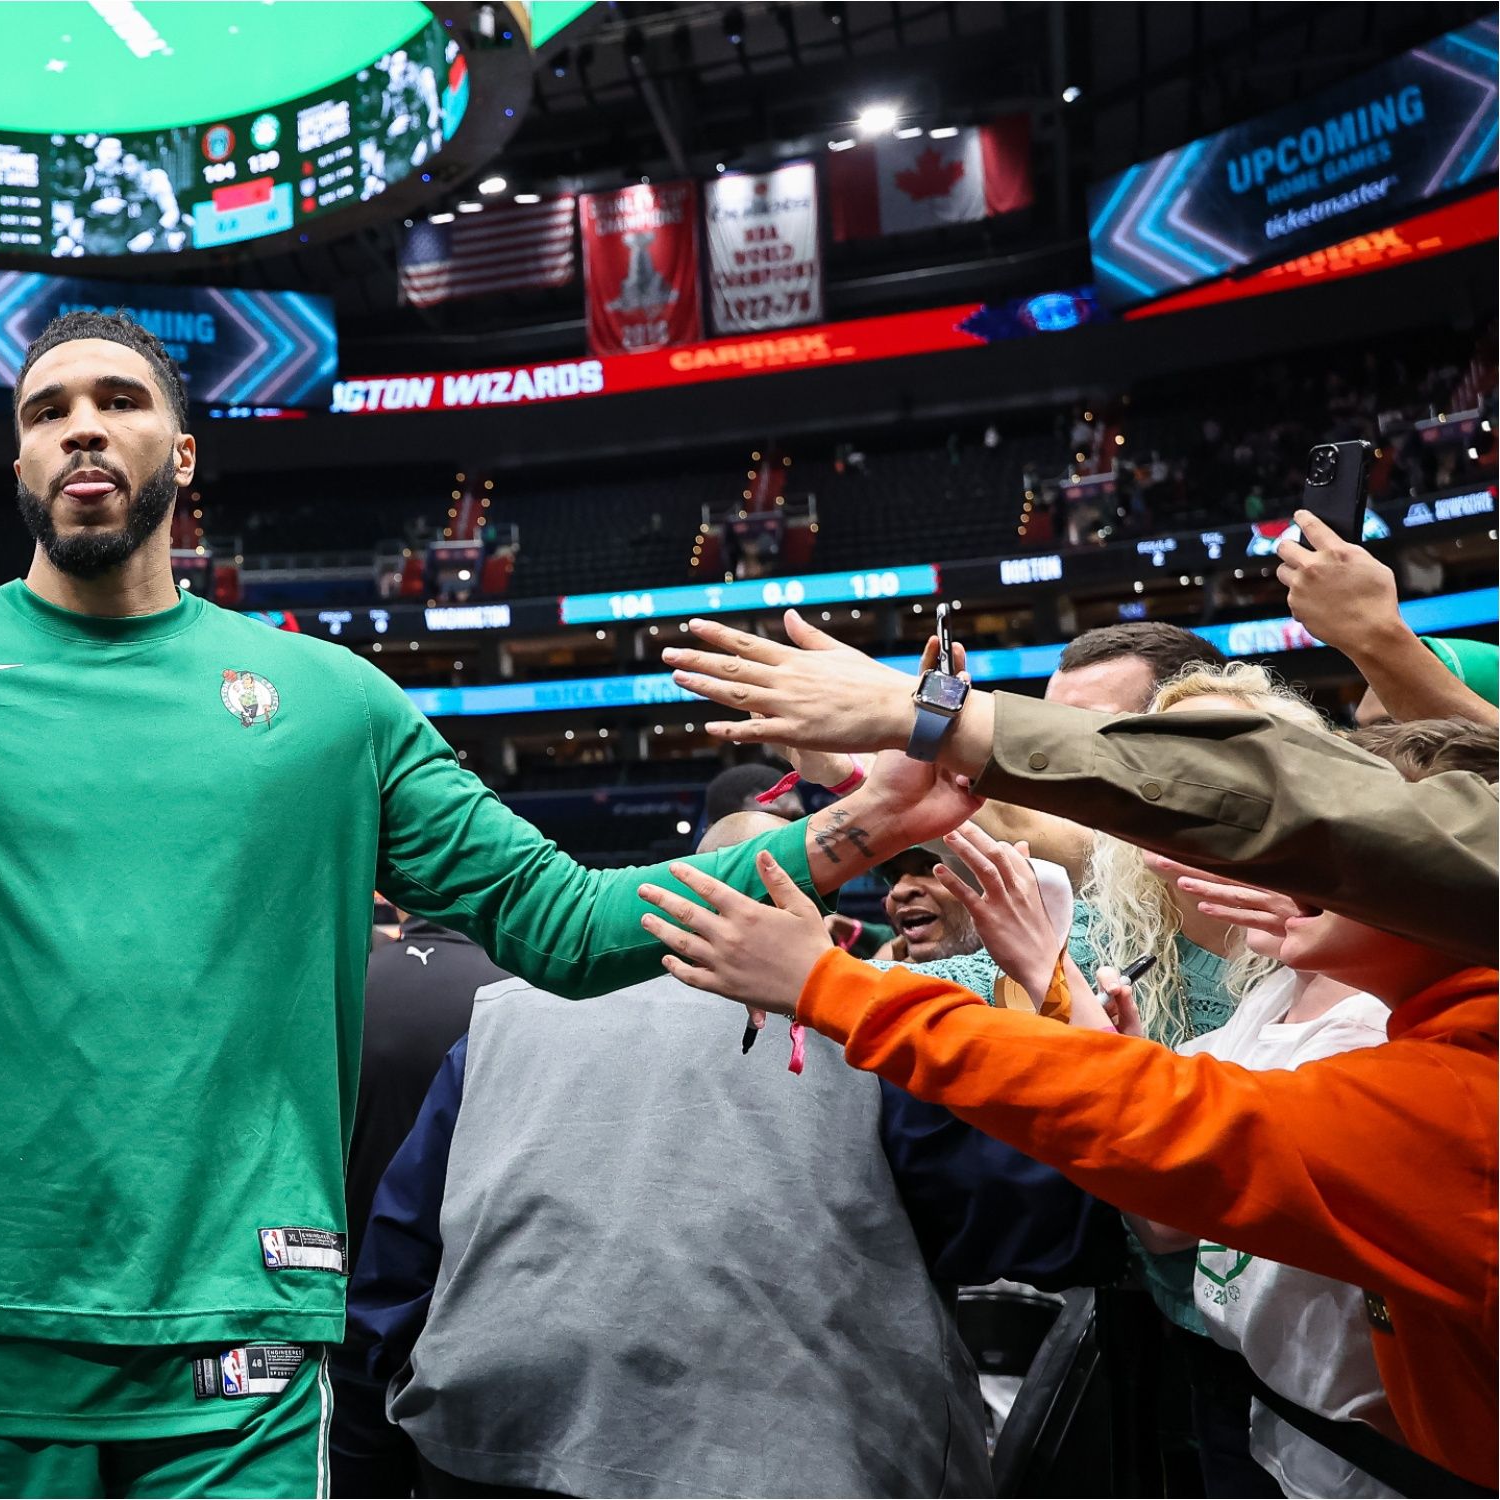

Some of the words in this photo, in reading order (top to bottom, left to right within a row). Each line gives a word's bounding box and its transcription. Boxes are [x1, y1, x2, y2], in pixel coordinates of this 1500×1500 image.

[1226, 85, 1425, 194] UPCOMING
[1265, 169, 1320, 205] HOME
[1324, 139, 1392, 184] GAMES
[1264, 177, 1392, 241] ticketmaster
[443, 360, 604, 407] WIZARDS
[1001, 555, 1062, 585] BOSTON
[609, 593, 655, 619] 104
[762, 580, 805, 606] 0.0
[850, 572, 899, 599] 130
[288, 1233, 299, 1242] XL
